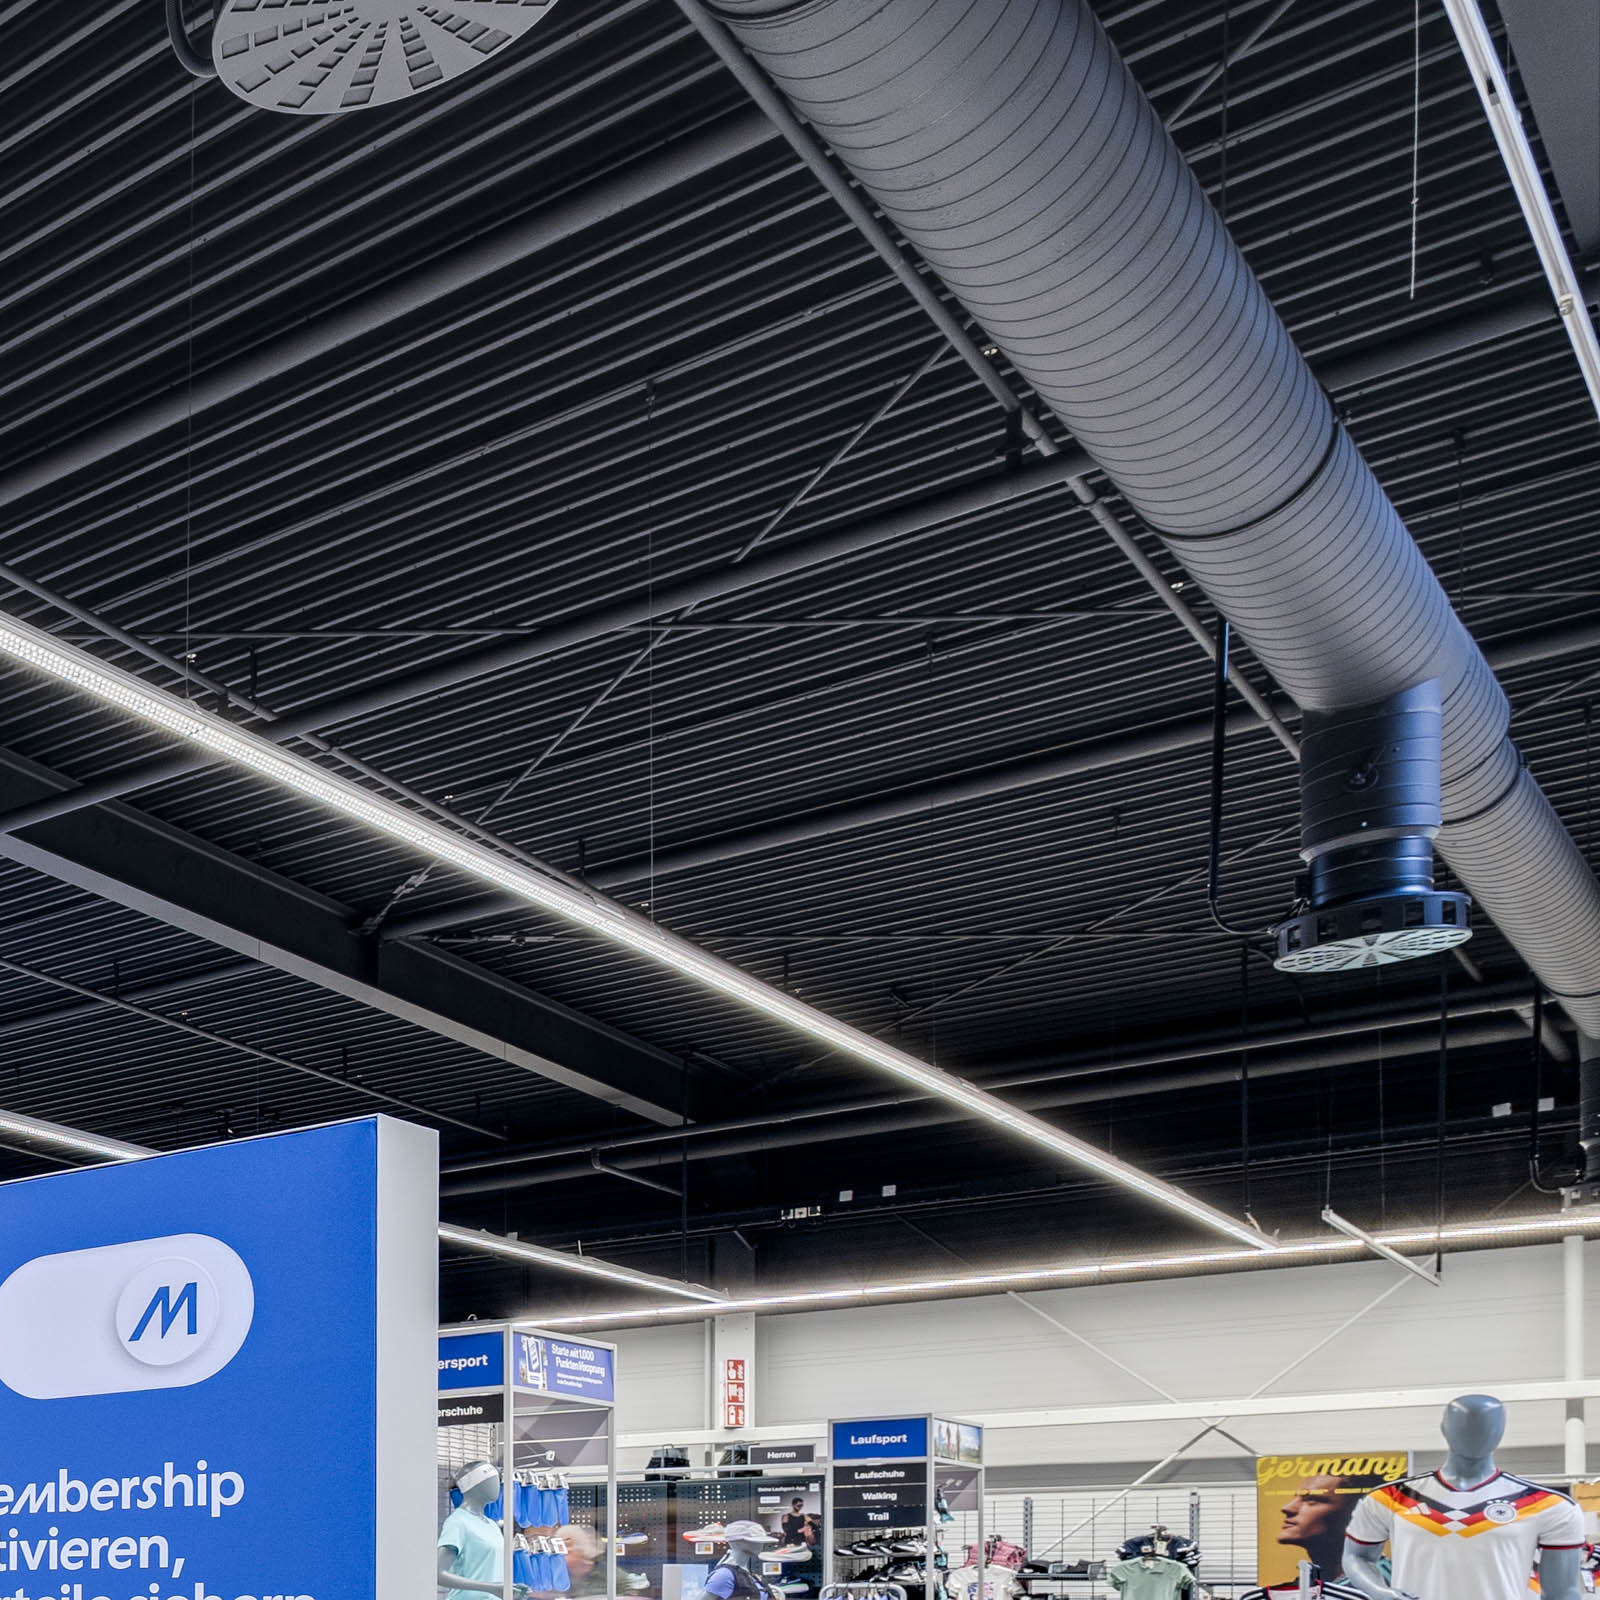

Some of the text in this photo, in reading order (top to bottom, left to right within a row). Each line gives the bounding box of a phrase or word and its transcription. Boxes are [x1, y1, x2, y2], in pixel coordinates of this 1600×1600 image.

[128, 1281, 199, 1343] M
[438, 1353, 489, 1371] ersport
[438, 1404, 484, 1418] erschuhe
[850, 1433, 908, 1446] Laufsport
[766, 1451, 797, 1460] Herren
[854, 1470, 905, 1480] Laufschuhe
[1256, 1455, 1408, 1486] Germany
[862, 1491, 898, 1502] Walking
[867, 1512, 890, 1522] Trail
